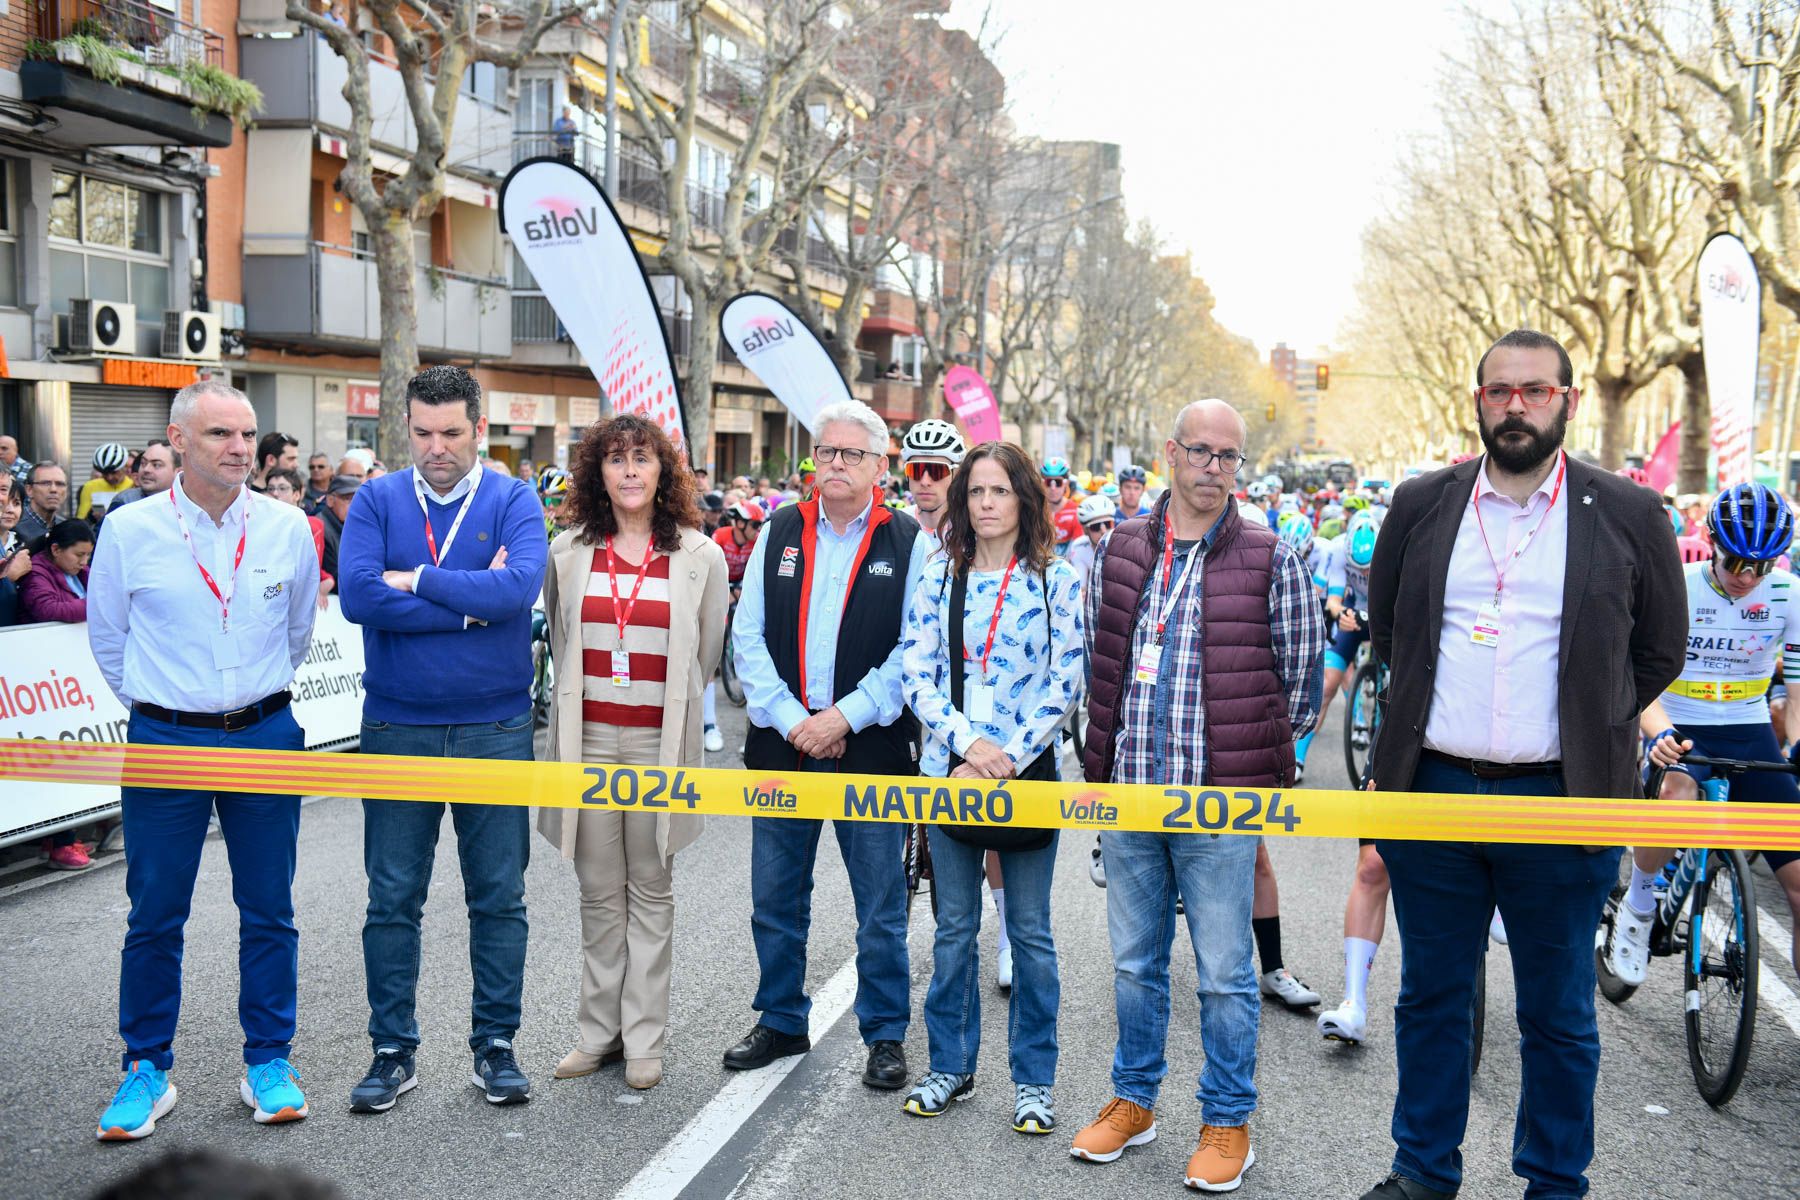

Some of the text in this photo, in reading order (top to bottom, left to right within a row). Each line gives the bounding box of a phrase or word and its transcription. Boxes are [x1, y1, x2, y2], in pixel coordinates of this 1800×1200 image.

[868, 564, 893, 575] Volta
[1703, 660, 1732, 669] TECH
[581, 767, 1302, 832] 2024 Volta MATARÓ Volta 2024
